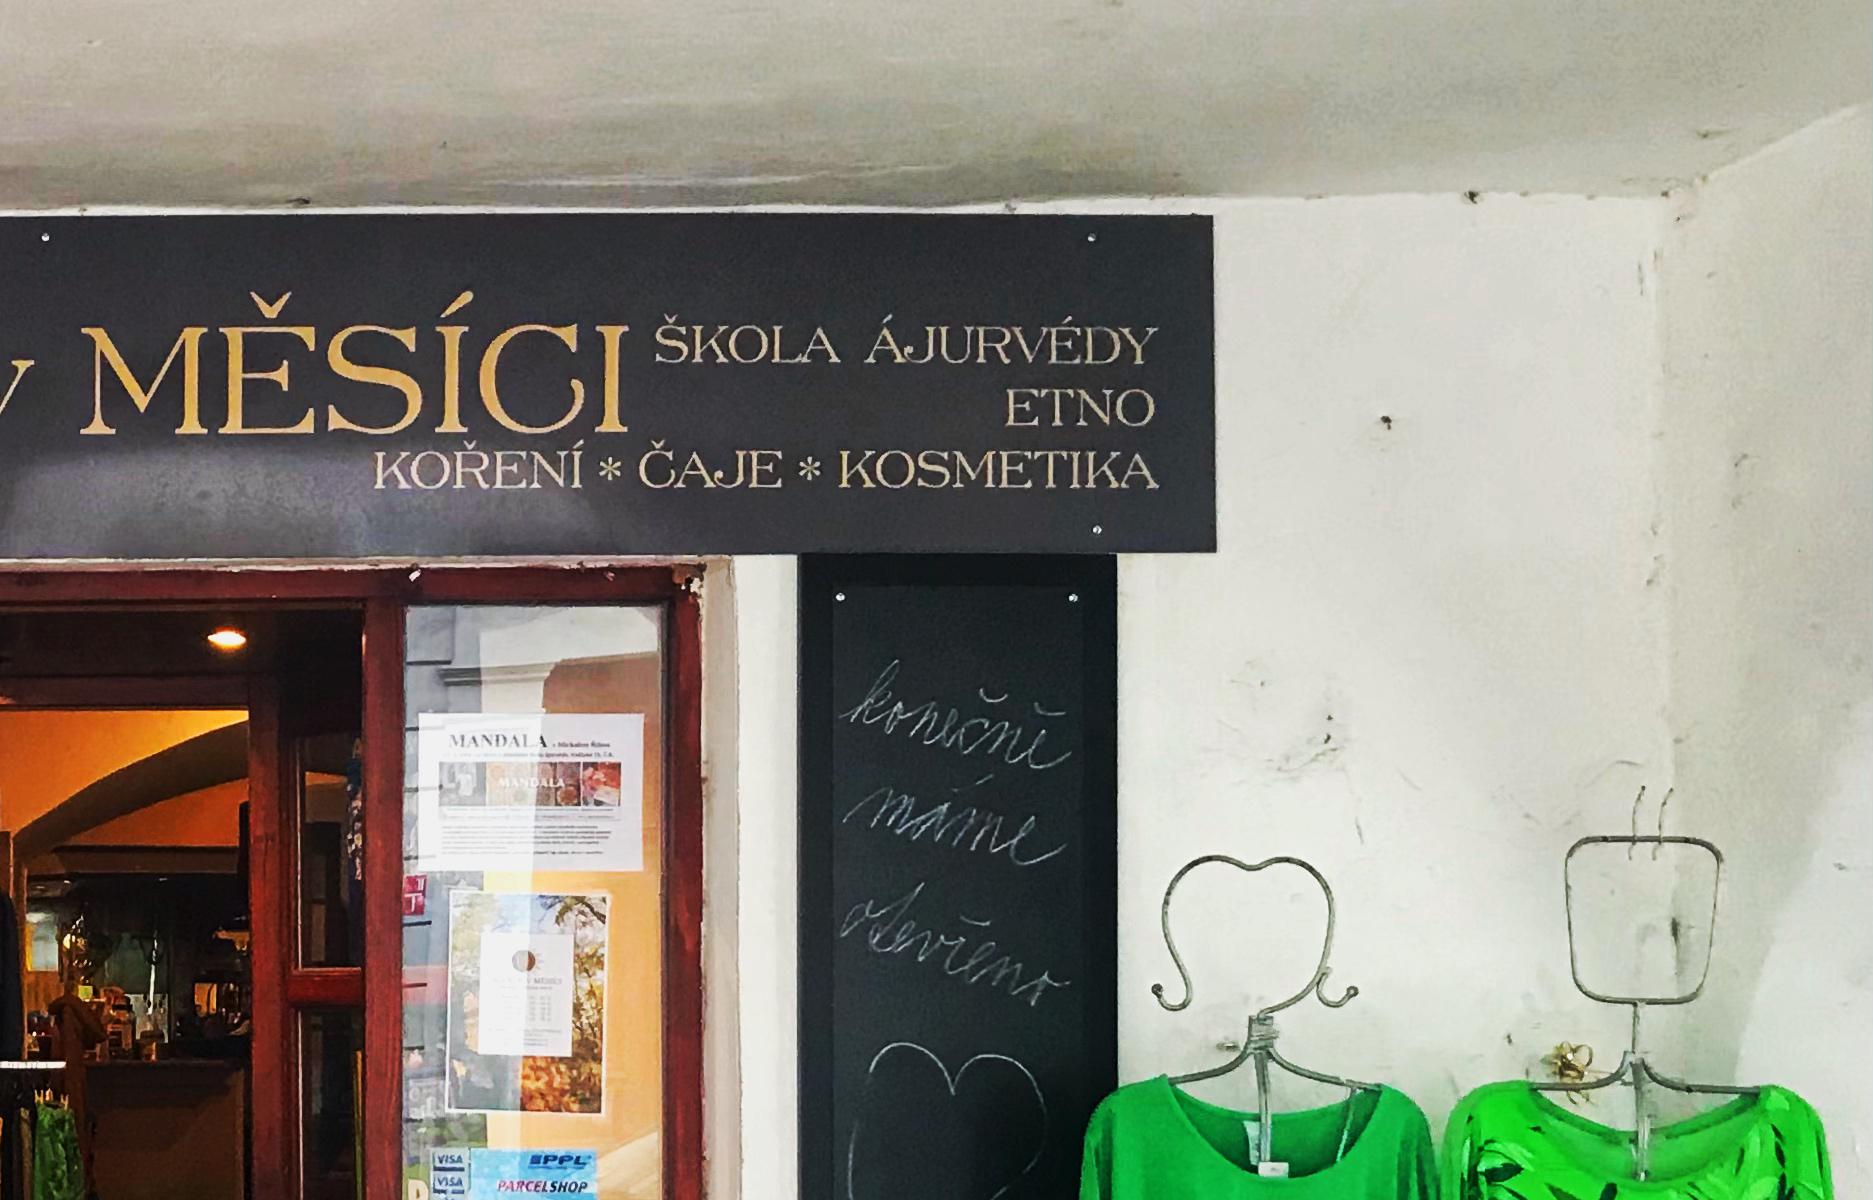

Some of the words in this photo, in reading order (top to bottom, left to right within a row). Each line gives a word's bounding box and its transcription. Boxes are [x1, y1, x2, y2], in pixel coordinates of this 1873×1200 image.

[654, 313, 841, 364] ŠKOLA
[864, 314, 1160, 366] ÁJURVÉDY
[79, 290, 629, 435] MĚSÍCI
[1004, 388, 1156, 428] ETNO
[372, 439, 585, 490] KOŘENÍ
[637, 439, 784, 490] ČAJE
[837, 450, 1160, 490] KOSMETIKA
[449, 733, 548, 749] MANDALA
[437, 1153, 464, 1165] VISA
[497, 1179, 589, 1194] PARCELSHOP
